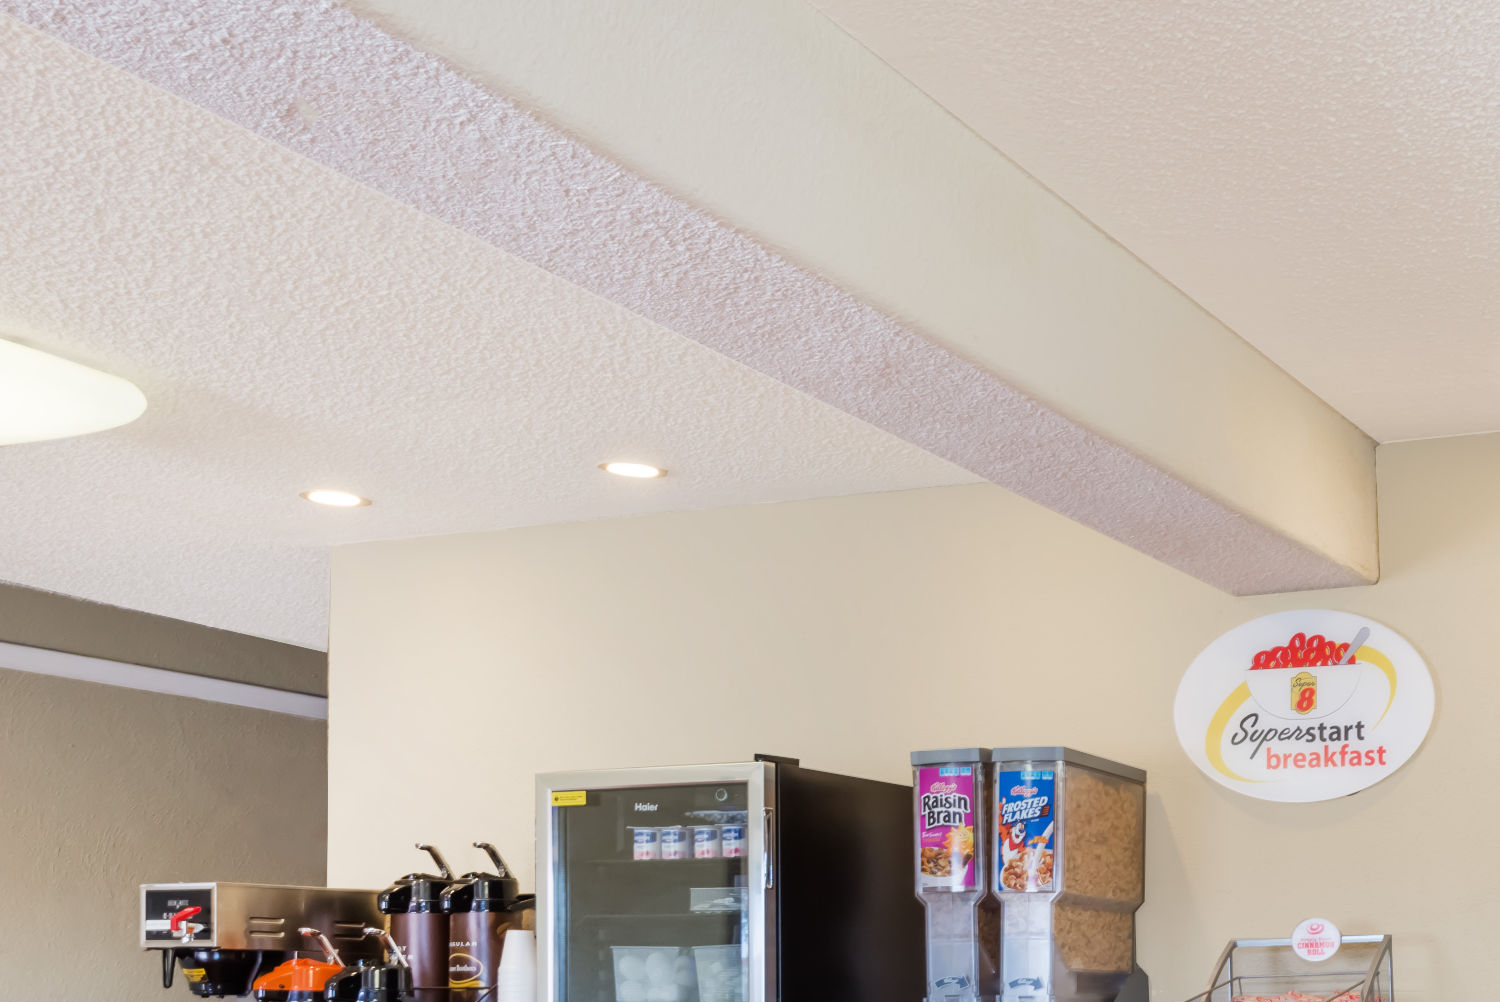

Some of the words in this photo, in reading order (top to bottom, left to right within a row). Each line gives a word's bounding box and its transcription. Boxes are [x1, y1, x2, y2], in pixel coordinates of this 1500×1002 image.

[1292, 677, 1316, 692] Super
[1296, 687, 1316, 712] 8
[1231, 712, 1365, 760] Superstart
[1266, 744, 1387, 770] breakfast
[634, 802, 659, 812] Haier
[922, 793, 970, 814] Raisin
[1002, 796, 1048, 815] FROSTED
[926, 809, 964, 828] Bran
[1002, 806, 1041, 825] FLAKES
